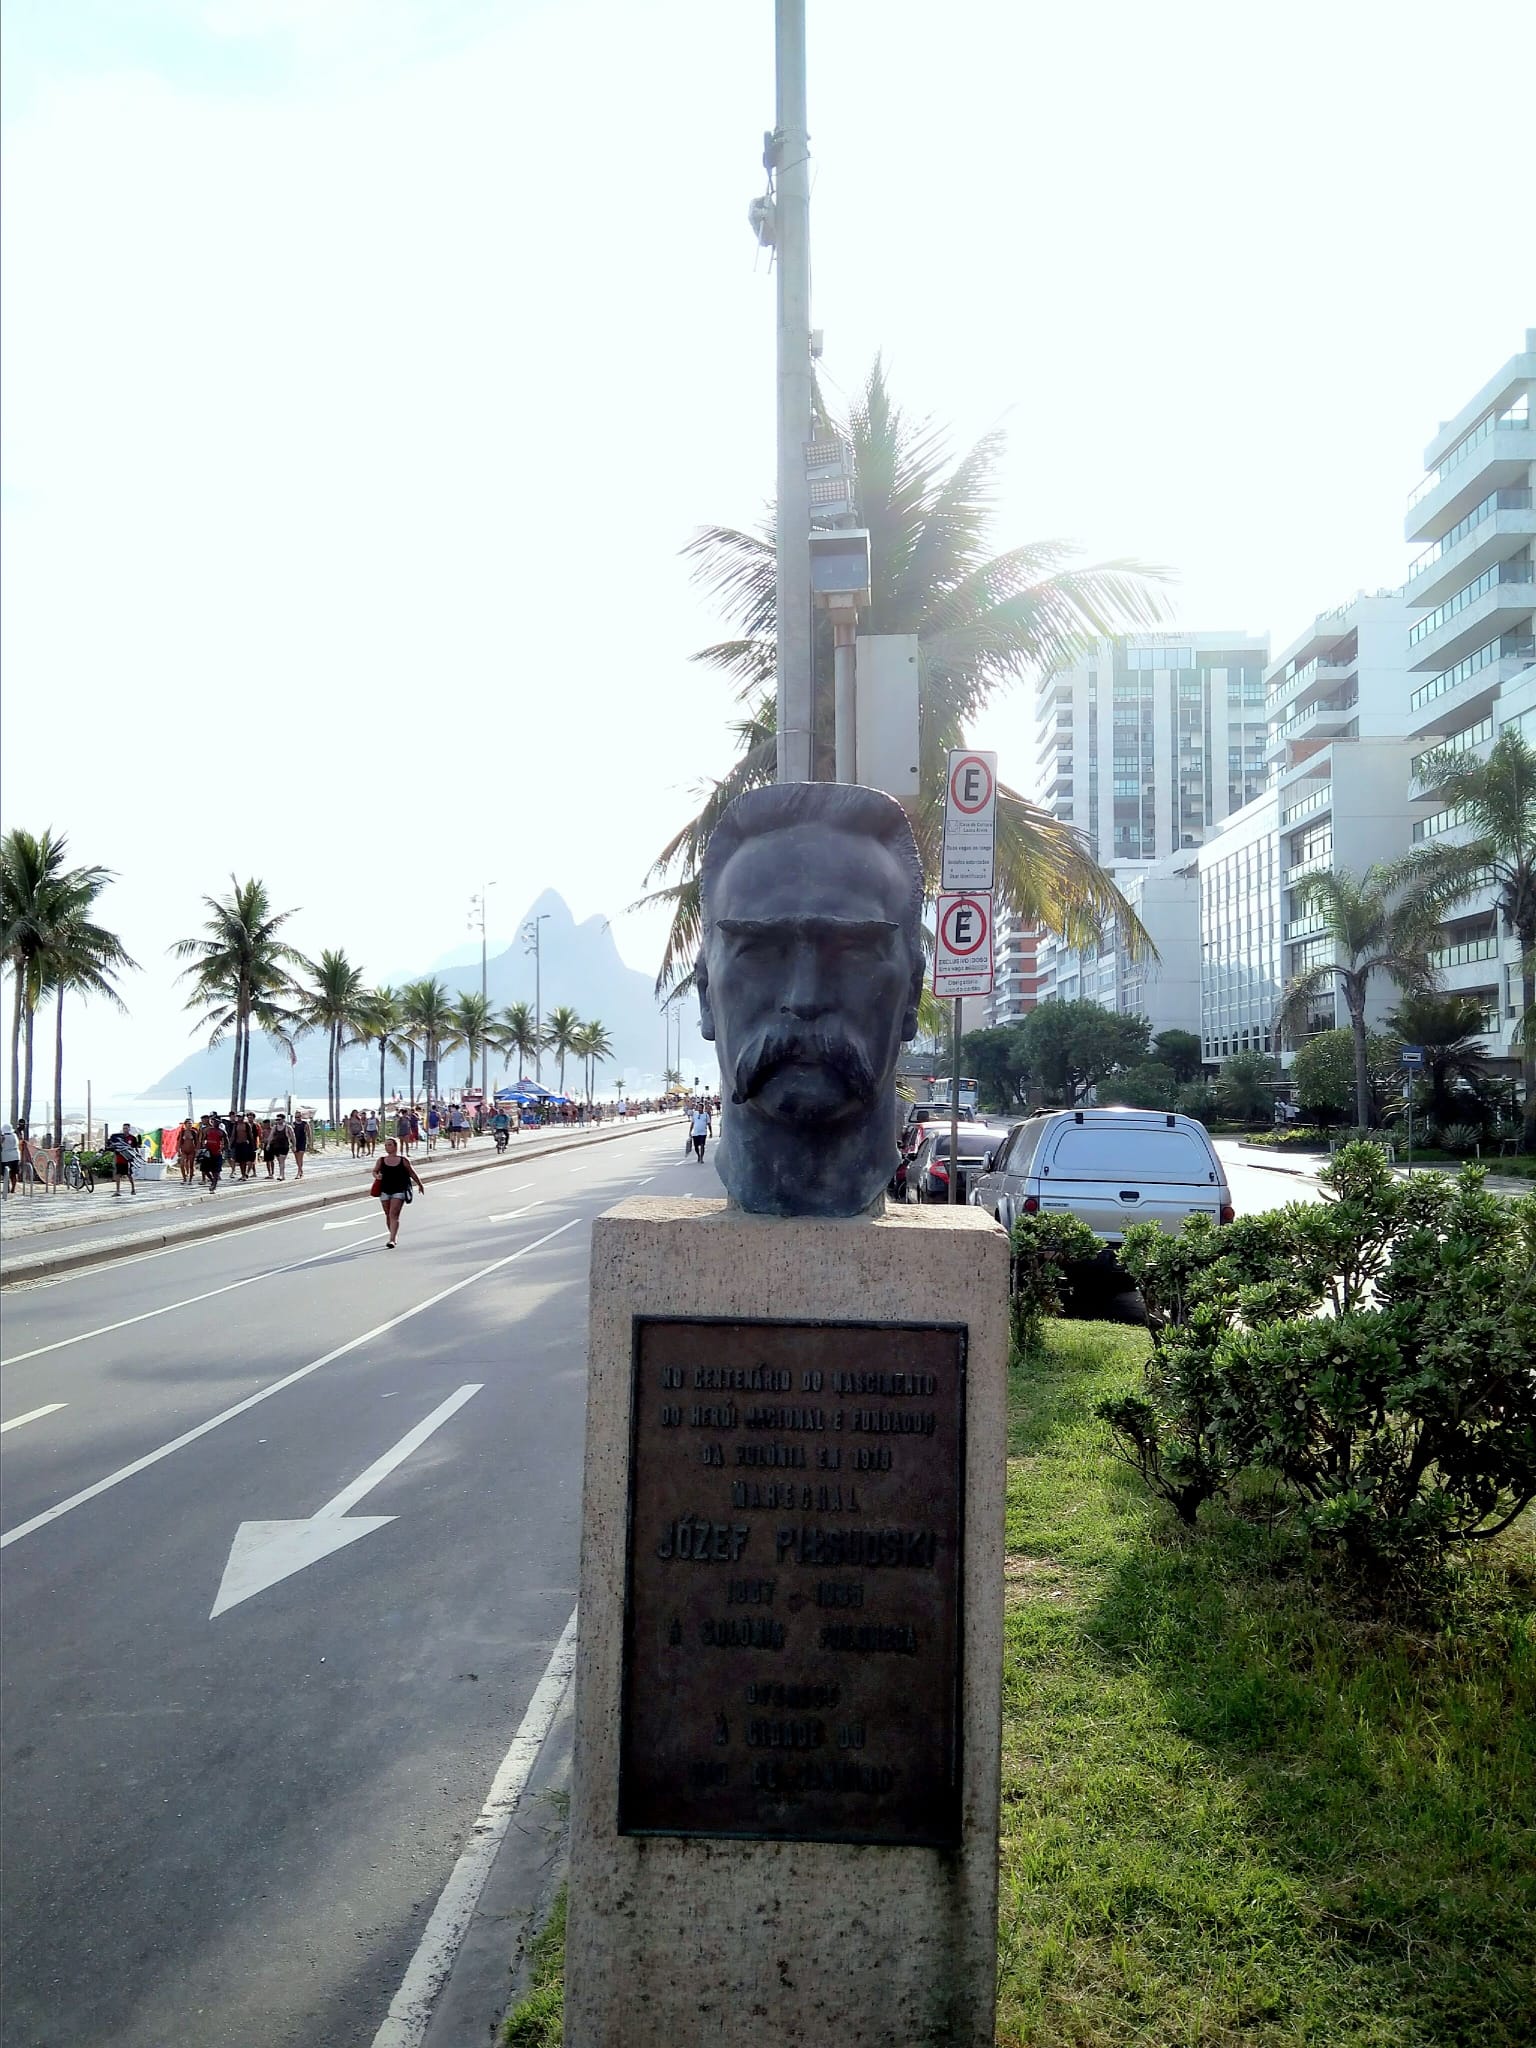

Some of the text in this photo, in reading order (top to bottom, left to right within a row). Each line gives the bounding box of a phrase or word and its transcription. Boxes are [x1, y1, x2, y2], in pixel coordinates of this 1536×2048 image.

[965, 769, 980, 801] E
[956, 912, 972, 943] E
[661, 1366, 683, 1391] NO
[694, 1361, 792, 1392] CENTENÁRIO
[801, 1370, 824, 1393] DO
[661, 1406, 681, 1427] DO
[832, 1411, 843, 1432] E
